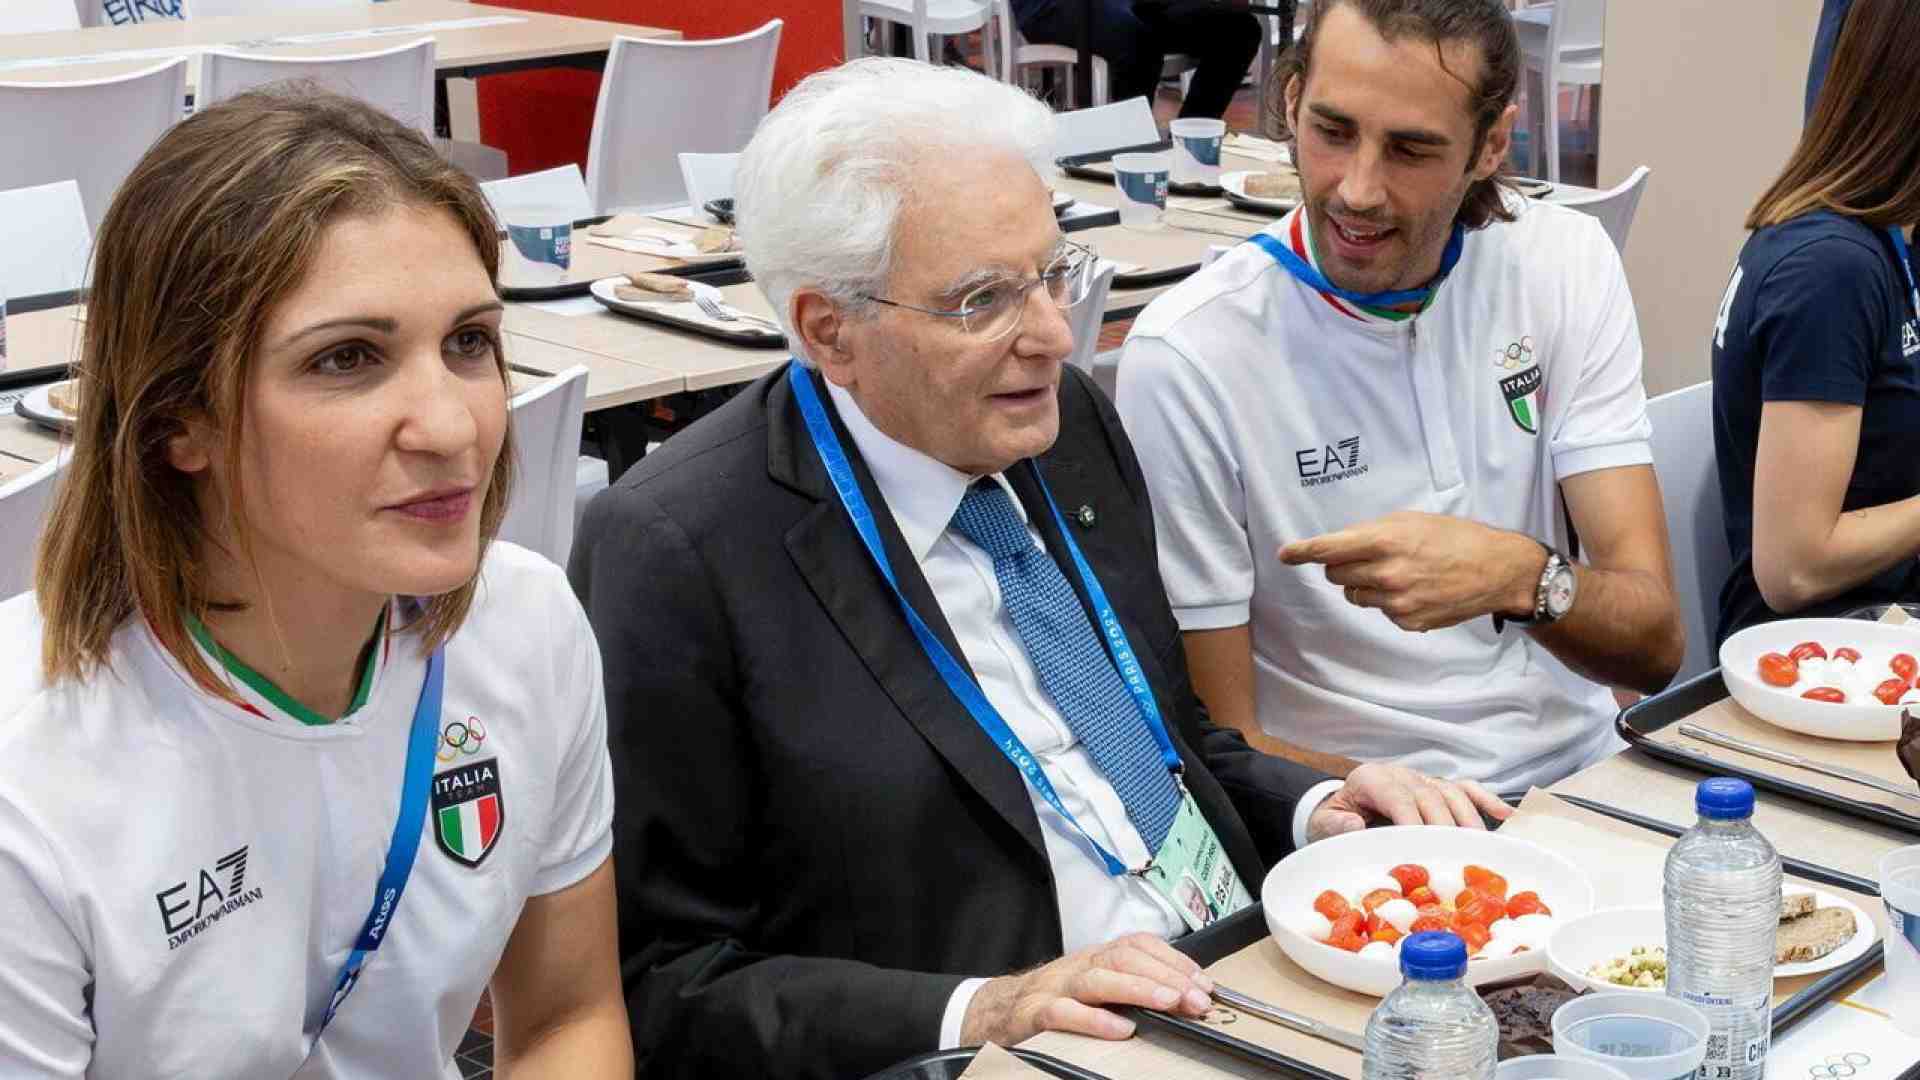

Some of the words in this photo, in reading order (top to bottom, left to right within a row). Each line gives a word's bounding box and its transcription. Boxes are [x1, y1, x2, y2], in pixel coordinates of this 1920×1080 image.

[1504, 369, 1540, 393] ITALIA
[1296, 435, 1360, 478] EA7
[1102, 608, 1125, 648] 2024
[1118, 651, 1145, 695] PARIS
[435, 767, 494, 795] ITALIA
[156, 844, 249, 935] EA7
